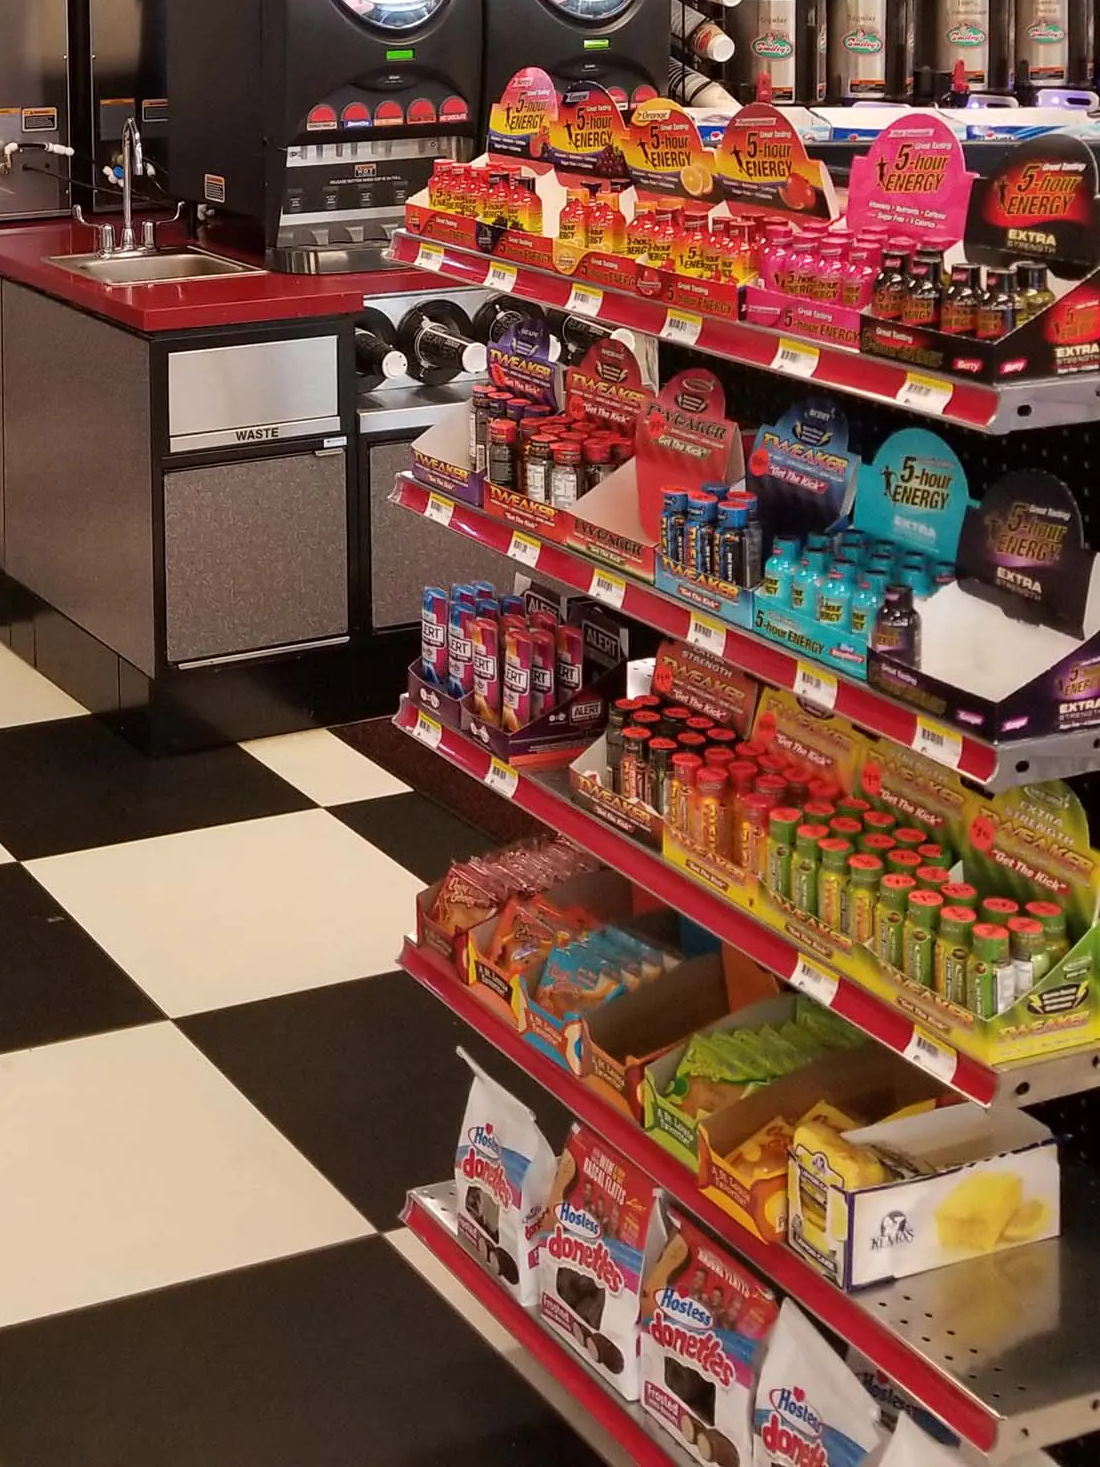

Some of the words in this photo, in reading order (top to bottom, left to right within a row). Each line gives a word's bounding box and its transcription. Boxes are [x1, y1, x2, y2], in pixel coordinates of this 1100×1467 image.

[515, 92, 547, 113] 5-hour
[510, 114, 545, 131] ENERGY
[576, 107, 612, 131] 5-hour
[642, 110, 668, 121] Orange
[574, 131, 613, 149] ENERGY
[650, 125, 689, 150] 5-hour
[747, 132, 792, 159] 5-hour
[914, 142, 931, 150] Great
[651, 151, 691, 168] ENERGY
[894, 144, 949, 171] 5-hour
[745, 161, 793, 178] ENERGY
[1017, 164, 1082, 193] 5-hour
[884, 173, 945, 193] ENERGY
[1006, 195, 1076, 216] ENERGY
[1008, 228, 1057, 247] EXTRA
[797, 306, 813, 316] Great
[819, 326, 861, 343] ENERGY
[875, 327, 892, 337] Great
[1055, 343, 1100, 358] EXTRA
[490, 349, 551, 379] TWEAKER
[956, 360, 981, 372] Berry
[1002, 360, 1024, 373] Berry
[572, 373, 646, 404] TWEAKER
[599, 405, 610, 418] The
[235, 427, 280, 441] WASTE
[763, 432, 849, 475] TWEAKER
[414, 451, 469, 483] TWEAKER
[900, 456, 953, 489] 5-hour
[490, 485, 557, 518] TWEAKER
[892, 485, 949, 510] ENERGY
[1008, 503, 1068, 544] 5-hour
[1028, 504, 1048, 516] Great
[1048, 508, 1072, 522] Tasting
[998, 534, 1063, 562] ENERGY
[662, 555, 740, 600] TWEAKER
[996, 566, 1043, 594] EXTRA
[422, 625, 441, 640] ERT
[587, 629, 618, 655] ALERT
[755, 609, 788, 640] 5-hour
[787, 631, 825, 655] ENERGY
[451, 641, 469, 655] ERT
[474, 656, 491, 672] ERT
[682, 650, 733, 678] STRENGTH
[506, 668, 525, 684] ERT
[574, 705, 601, 717] ALERT
[689, 695, 703, 710] The
[793, 742, 807, 757] The
[578, 775, 652, 824] TWEAKER
[899, 798, 915, 815] The
[1015, 860, 1034, 878] The
[673, 1118, 694, 1141] Louis
[559, 1202, 599, 1235] Hostess
[547, 1226, 625, 1295] donettes
[660, 1286, 712, 1326] Hostess
[649, 1308, 736, 1388] donettes
[646, 1383, 679, 1416] Frosted
